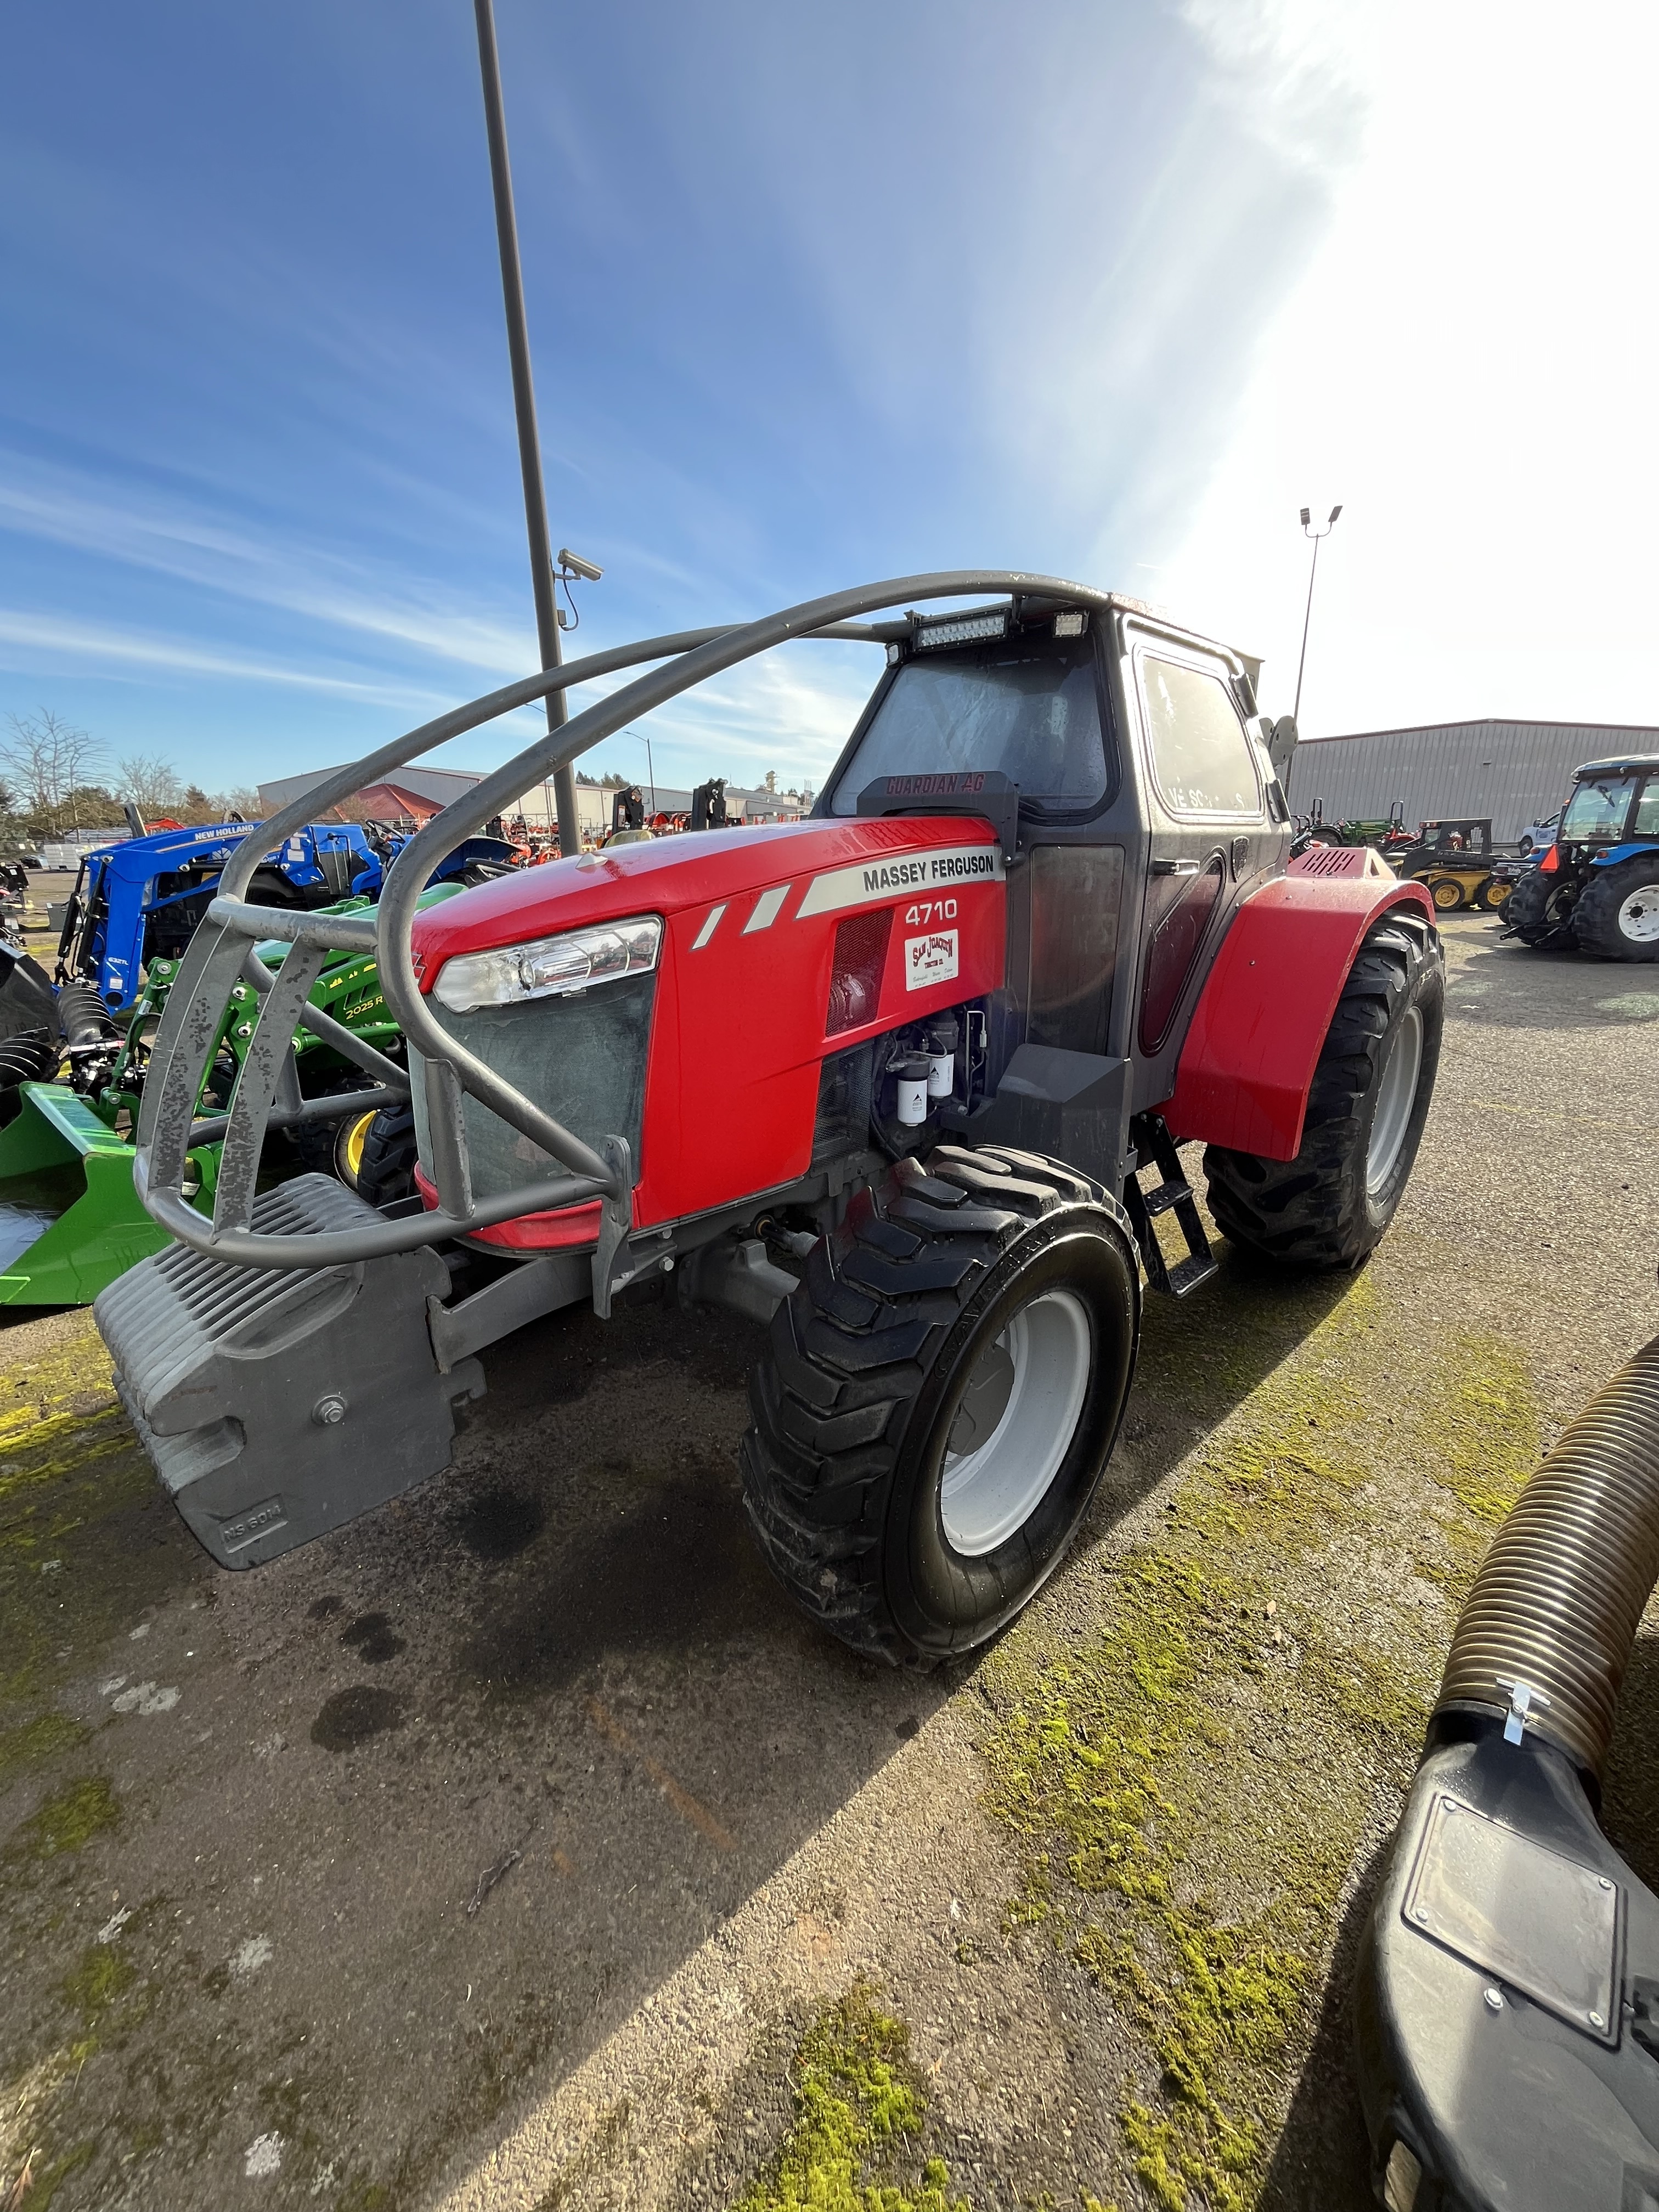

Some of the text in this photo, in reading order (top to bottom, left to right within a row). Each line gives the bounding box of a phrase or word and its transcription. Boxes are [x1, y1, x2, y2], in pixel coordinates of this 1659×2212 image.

[886, 772, 985, 795] GUARDIAN AG
[195, 825, 255, 840] NEW HOLLAND
[863, 855, 994, 892] MASSEY FERGUSON
[905, 899, 957, 926] 4710
[345, 995, 383, 1020] 2025 R
